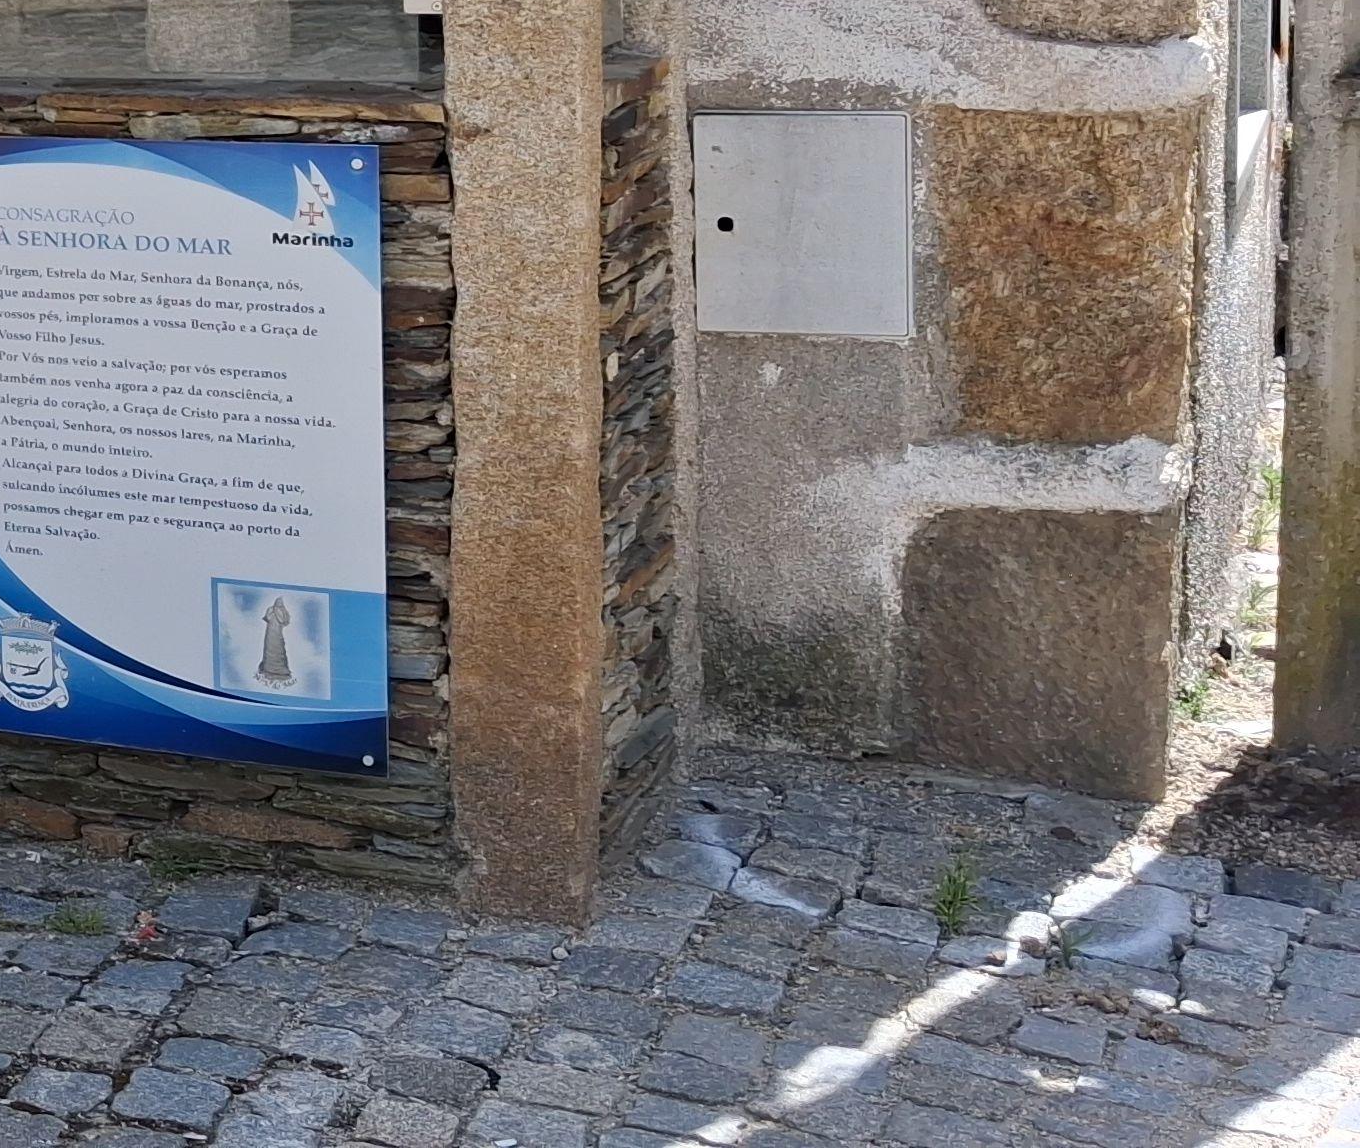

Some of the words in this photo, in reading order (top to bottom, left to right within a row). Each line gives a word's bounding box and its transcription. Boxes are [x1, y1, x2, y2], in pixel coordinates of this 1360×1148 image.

[17, 229, 129, 251] SENHORA
[134, 234, 170, 253] DO
[175, 237, 233, 256] MAR
[272, 232, 354, 248] Marinha
[45, 267, 87, 280] Estrela
[90, 269, 106, 281] do
[109, 270, 137, 284] Mar,
[140, 271, 193, 285] Senhora
[195, 274, 212, 286] da
[215, 275, 273, 292] Bonança,
[276, 278, 304, 292] nós,
[21, 288, 76, 301] andamos
[78, 293, 100, 305] por
[102, 292, 137, 304] sobre
[139, 296, 153, 306] as
[155, 294, 192, 309] águas
[195, 296, 212, 309] do
[215, 300, 243, 312] mar,
[246, 301, 315, 314] prostrados
[318, 306, 326, 315] a
[38, 309, 63, 324] pés,
[65, 310, 140, 327] imploramos
[142, 318, 149, 327] a
[152, 319, 187, 329] vossa
[239, 324, 247, 333] e
[249, 325, 257, 333] a
[260, 322, 299, 339] Graça
[302, 325, 318, 337] de
[68, 333, 105, 347] Jesus.
[21, 351, 45, 364] Vós
[47, 356, 69, 366] nos
[71, 355, 98, 367] veio
[100, 359, 108, 368] a
[111, 357, 167, 374] salvação;
[170, 364, 192, 376] por
[194, 364, 217, 375] vós
[219, 367, 288, 380] esperamos
[50, 378, 72, 387] nos
[74, 377, 111, 390] venha
[114, 382, 149, 395] agora
[151, 385, 159, 394] a
[162, 385, 184, 397] paz
[187, 384, 203, 397] da
[206, 387, 283, 405] consciência,
[286, 394, 294, 403] a
[0, 393, 39, 408] alegria
[42, 396, 58, 408] do
[112, 404, 120, 412] a
[123, 402, 159, 418] Graça
[162, 404, 178, 417] de
[180, 406, 219, 420] Cristo
[222, 412, 251, 424] para
[254, 414, 261, 423] a
[264, 415, 300, 426] nossa
[0, 415, 60, 431] Abençoai,
[62, 419, 116, 436] Senhora,
[119, 426, 133, 435] os
[136, 427, 178, 439] nossos
[181, 428, 214, 443] lares,
[217, 434, 233, 443] na
[236, 432, 296, 450] Marinha,
[0, 438, 7, 447] a
[10, 436, 49, 452] Pátria,
[51, 442, 59, 451] o
[62, 442, 106, 455] mundo
[108, 444, 153, 459] inteiro.
[1, 457, 53, 474] Alcançai
[56, 464, 82, 476] para
[85, 464, 119, 478] todos
[121, 469, 129, 479] a
[132, 468, 175, 482] Divina
[178, 472, 218, 488] Graça,
[221, 478, 229, 487] a
[232, 476, 254, 489] fim
[257, 478, 274, 491] de
[2, 479, 56, 494] sulcando
[58, 483, 121, 500] incólumes
[123, 491, 148, 502] este
[151, 494, 176, 504] mar
[178, 495, 259, 512] tempestuoso
[262, 501, 278, 513] da
[3, 502, 61, 515] possamos
[63, 505, 104, 521] chegar
[106, 512, 125, 521] em
[128, 514, 150, 526] paz
[153, 516, 160, 525] e
[163, 517, 226, 533] segurança
[228, 523, 244, 532] ao
[247, 525, 281, 537] porto
[284, 525, 301, 538] da
[4, 521, 42, 535] Eterna
[44, 524, 101, 542] Salvação.
